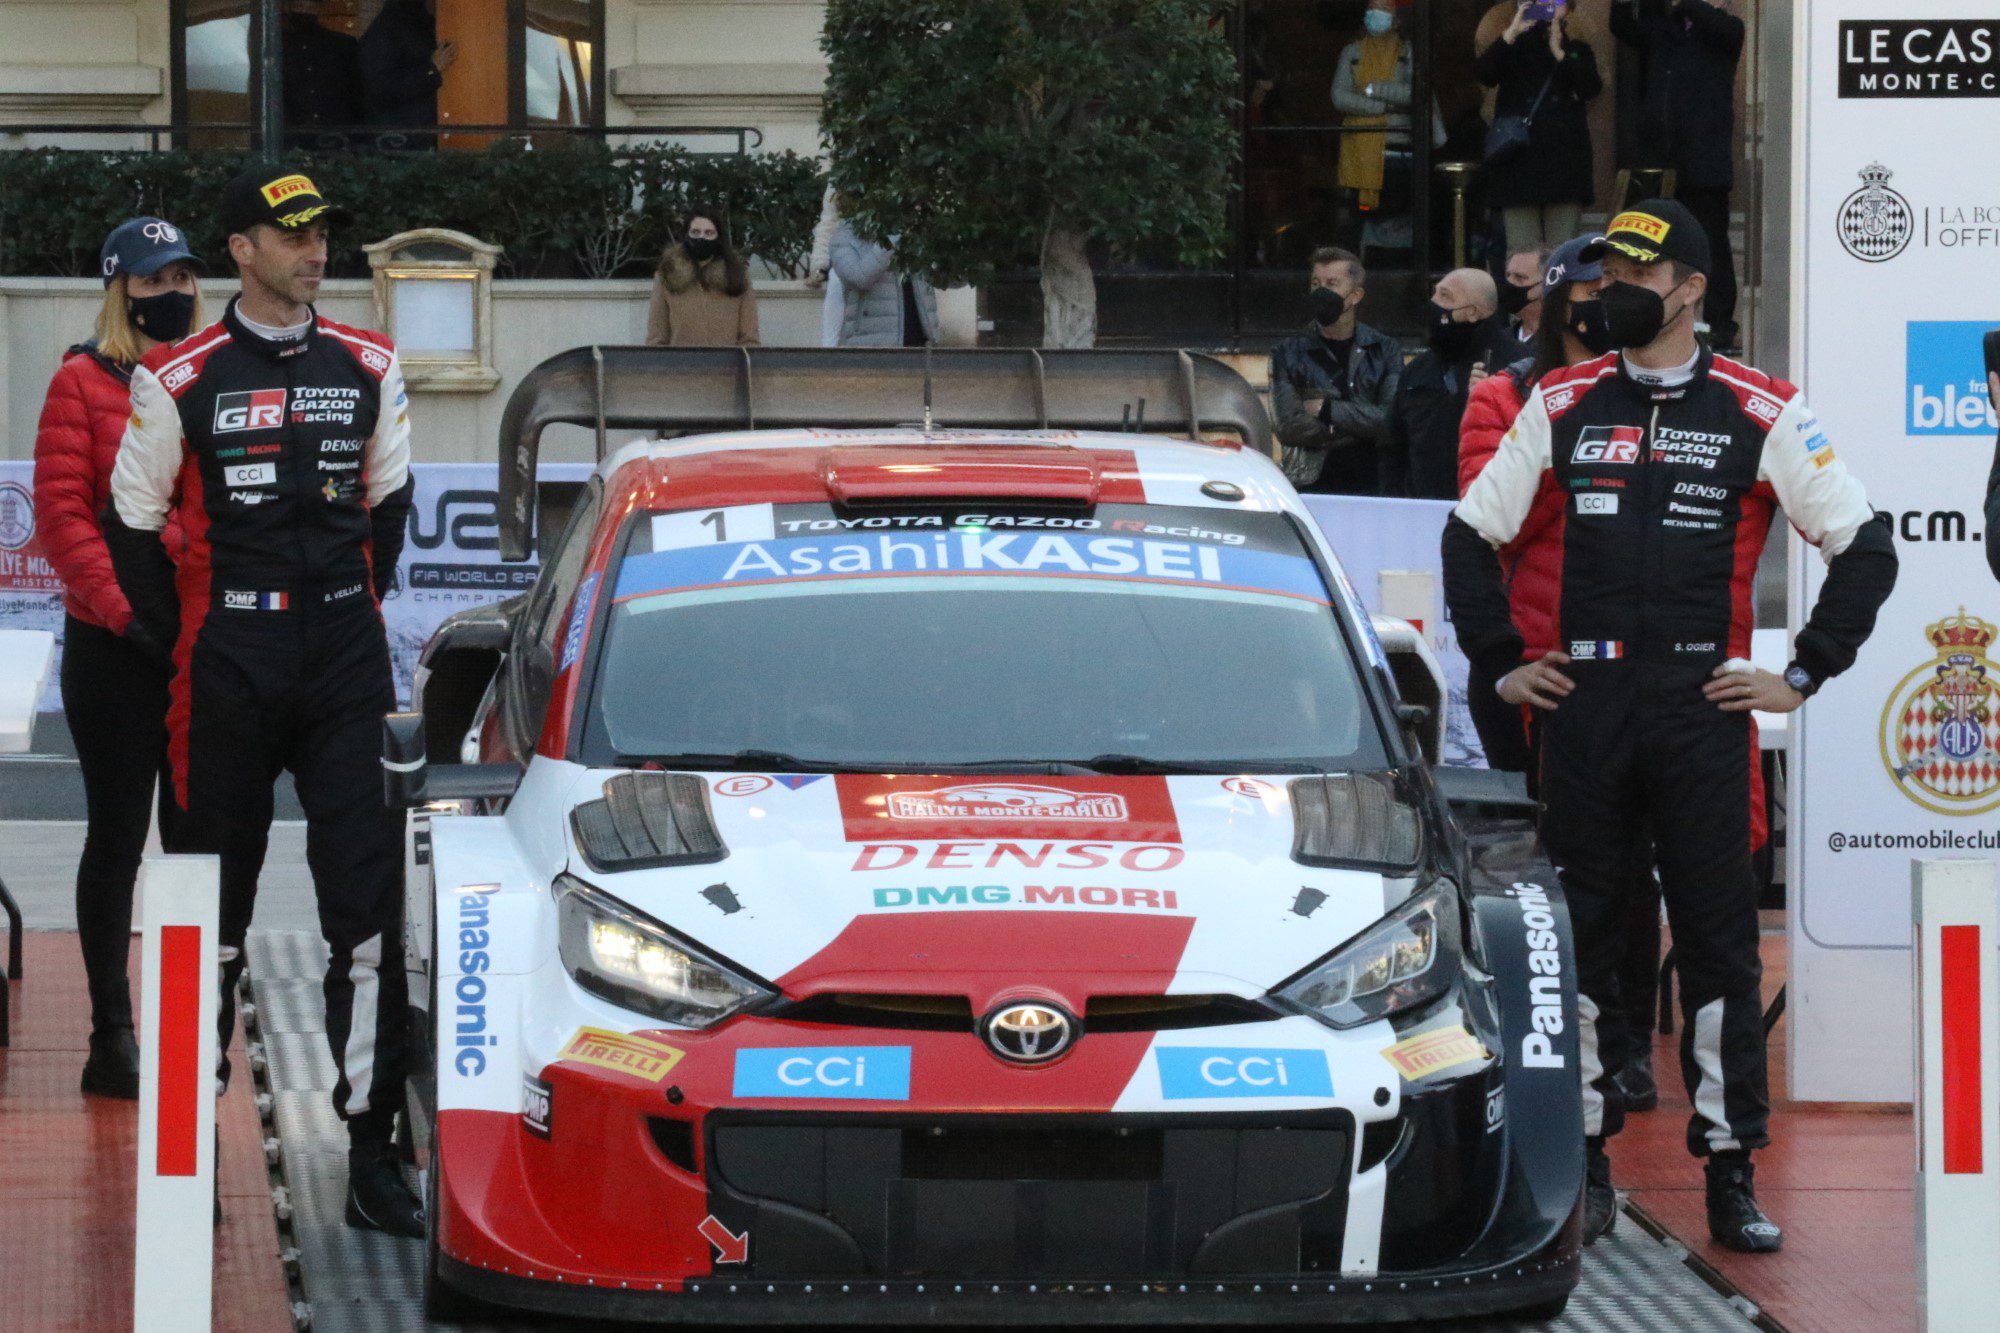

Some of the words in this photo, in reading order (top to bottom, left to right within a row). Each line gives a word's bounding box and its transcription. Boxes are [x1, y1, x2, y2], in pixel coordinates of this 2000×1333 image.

[1846, 29, 1890, 64] LE
[1902, 28, 1992, 63] CAS
[1940, 206, 1965, 224] LA
[1939, 228, 1999, 247] OFFI
[361, 349, 389, 372] OMP
[165, 364, 196, 389] OMP
[293, 387, 360, 399] TOYOTA
[1546, 390, 1574, 411] OMP
[291, 399, 355, 411] GAZOO
[1746, 397, 1779, 421] OMP
[217, 404, 281, 430] GR
[291, 411, 353, 425] Racing
[1658, 427, 1732, 445] TOYOTA
[1576, 440, 1638, 460] GR
[1652, 439, 1722, 456] GAZOO
[1652, 451, 1717, 469] Racing
[1673, 482, 1728, 500] DENSO
[1669, 502, 1723, 516] Panasonic
[700, 511, 727, 542] 1
[781, 516, 943, 532] TOYOTA
[954, 514, 1101, 529] GAZOO
[1111, 519, 1246, 545] Racing
[1663, 519, 1701, 528] RICHARD
[722, 534, 949, 580] Asahi
[961, 534, 1222, 582] KASEI
[414, 570, 439, 581] FIA
[445, 571, 507, 583] WORLD
[225, 591, 257, 608] OMP
[1571, 642, 1596, 658] OMP
[1674, 643, 1684, 651] S.
[1686, 643, 1716, 651] OGIER
[899, 800, 968, 816] RALLYE
[851, 842, 1186, 872] DENSO
[873, 885, 1011, 908] DMG
[1023, 885, 1178, 910] MORI
[1505, 882, 1565, 1068] Panasonic
[568, 1032, 672, 1073] PIRELLI
[777, 1056, 865, 1087] CCi
[1201, 1056, 1288, 1087] CCi
